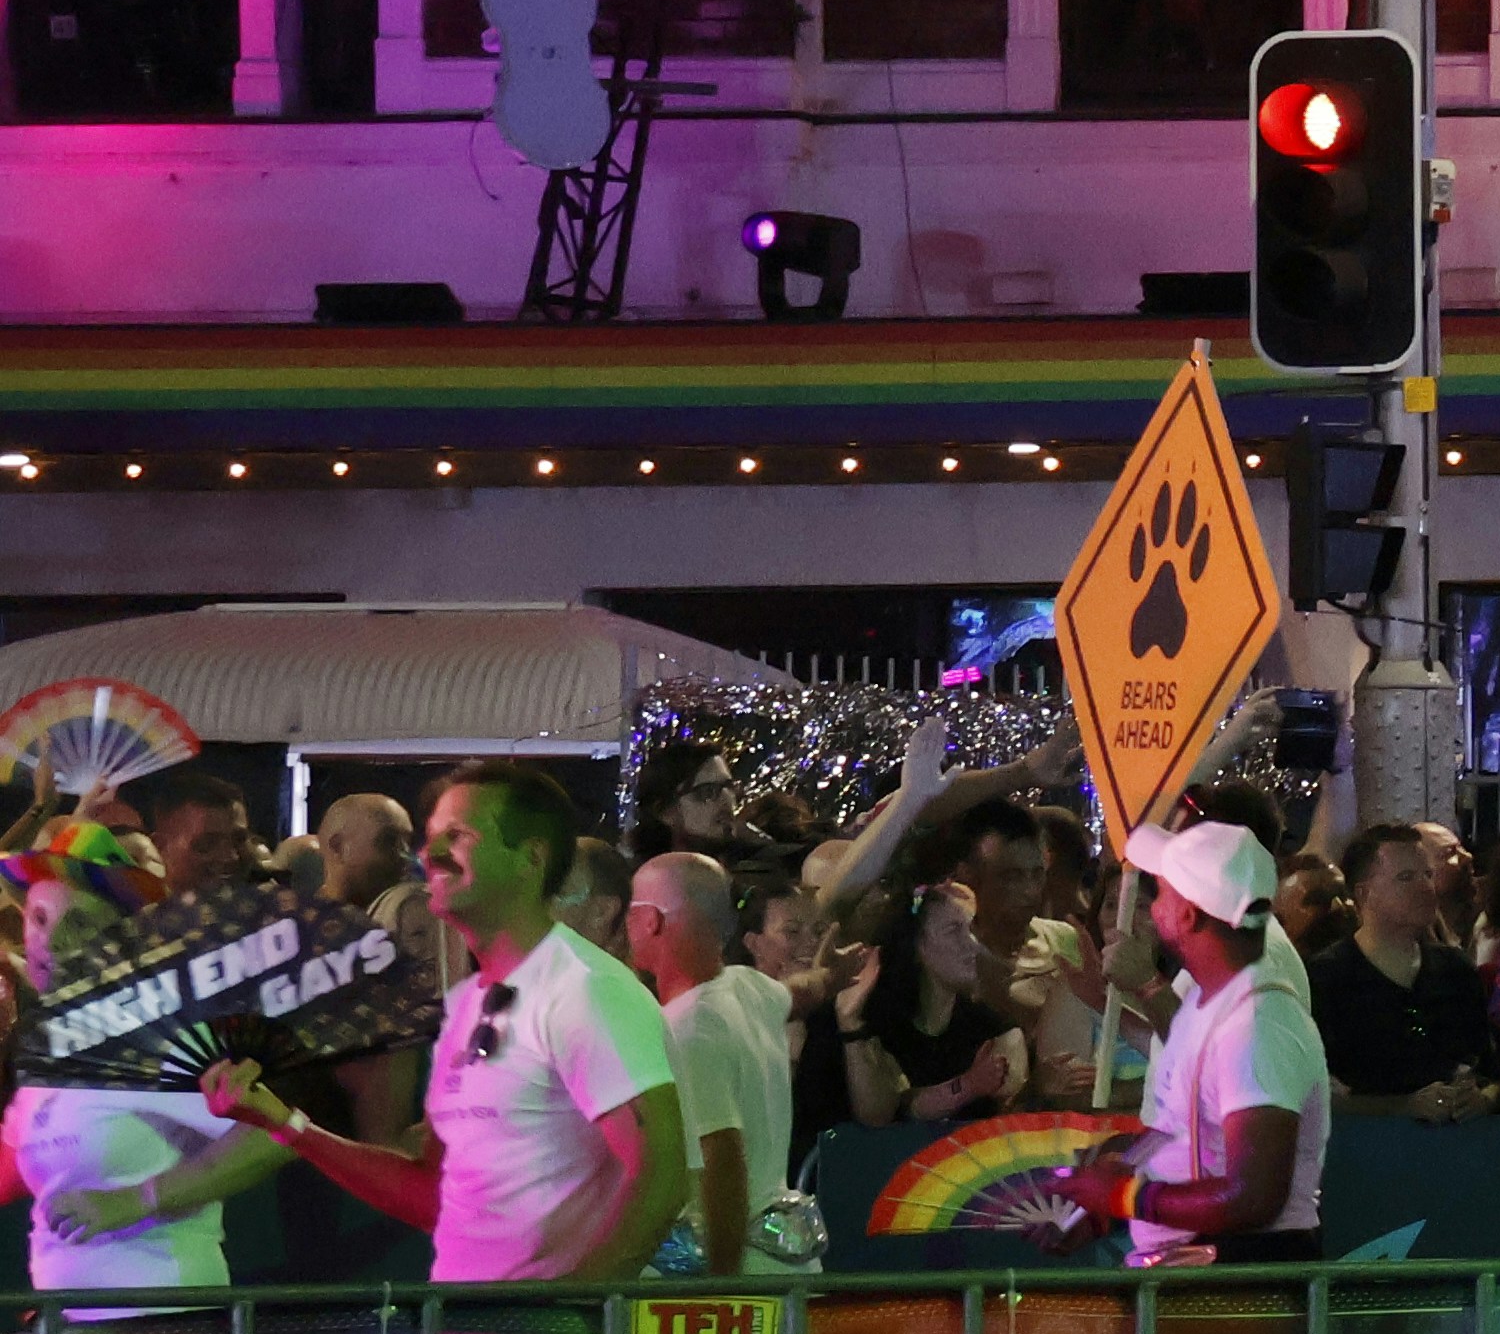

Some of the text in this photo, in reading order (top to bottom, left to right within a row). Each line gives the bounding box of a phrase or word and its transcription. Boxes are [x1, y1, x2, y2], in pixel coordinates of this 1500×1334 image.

[1120, 680, 1178, 711] BEARS
[1113, 720, 1174, 750] AHEAD
[45, 917, 300, 1059] HIGH END
[258, 928, 397, 1018] GAYS
